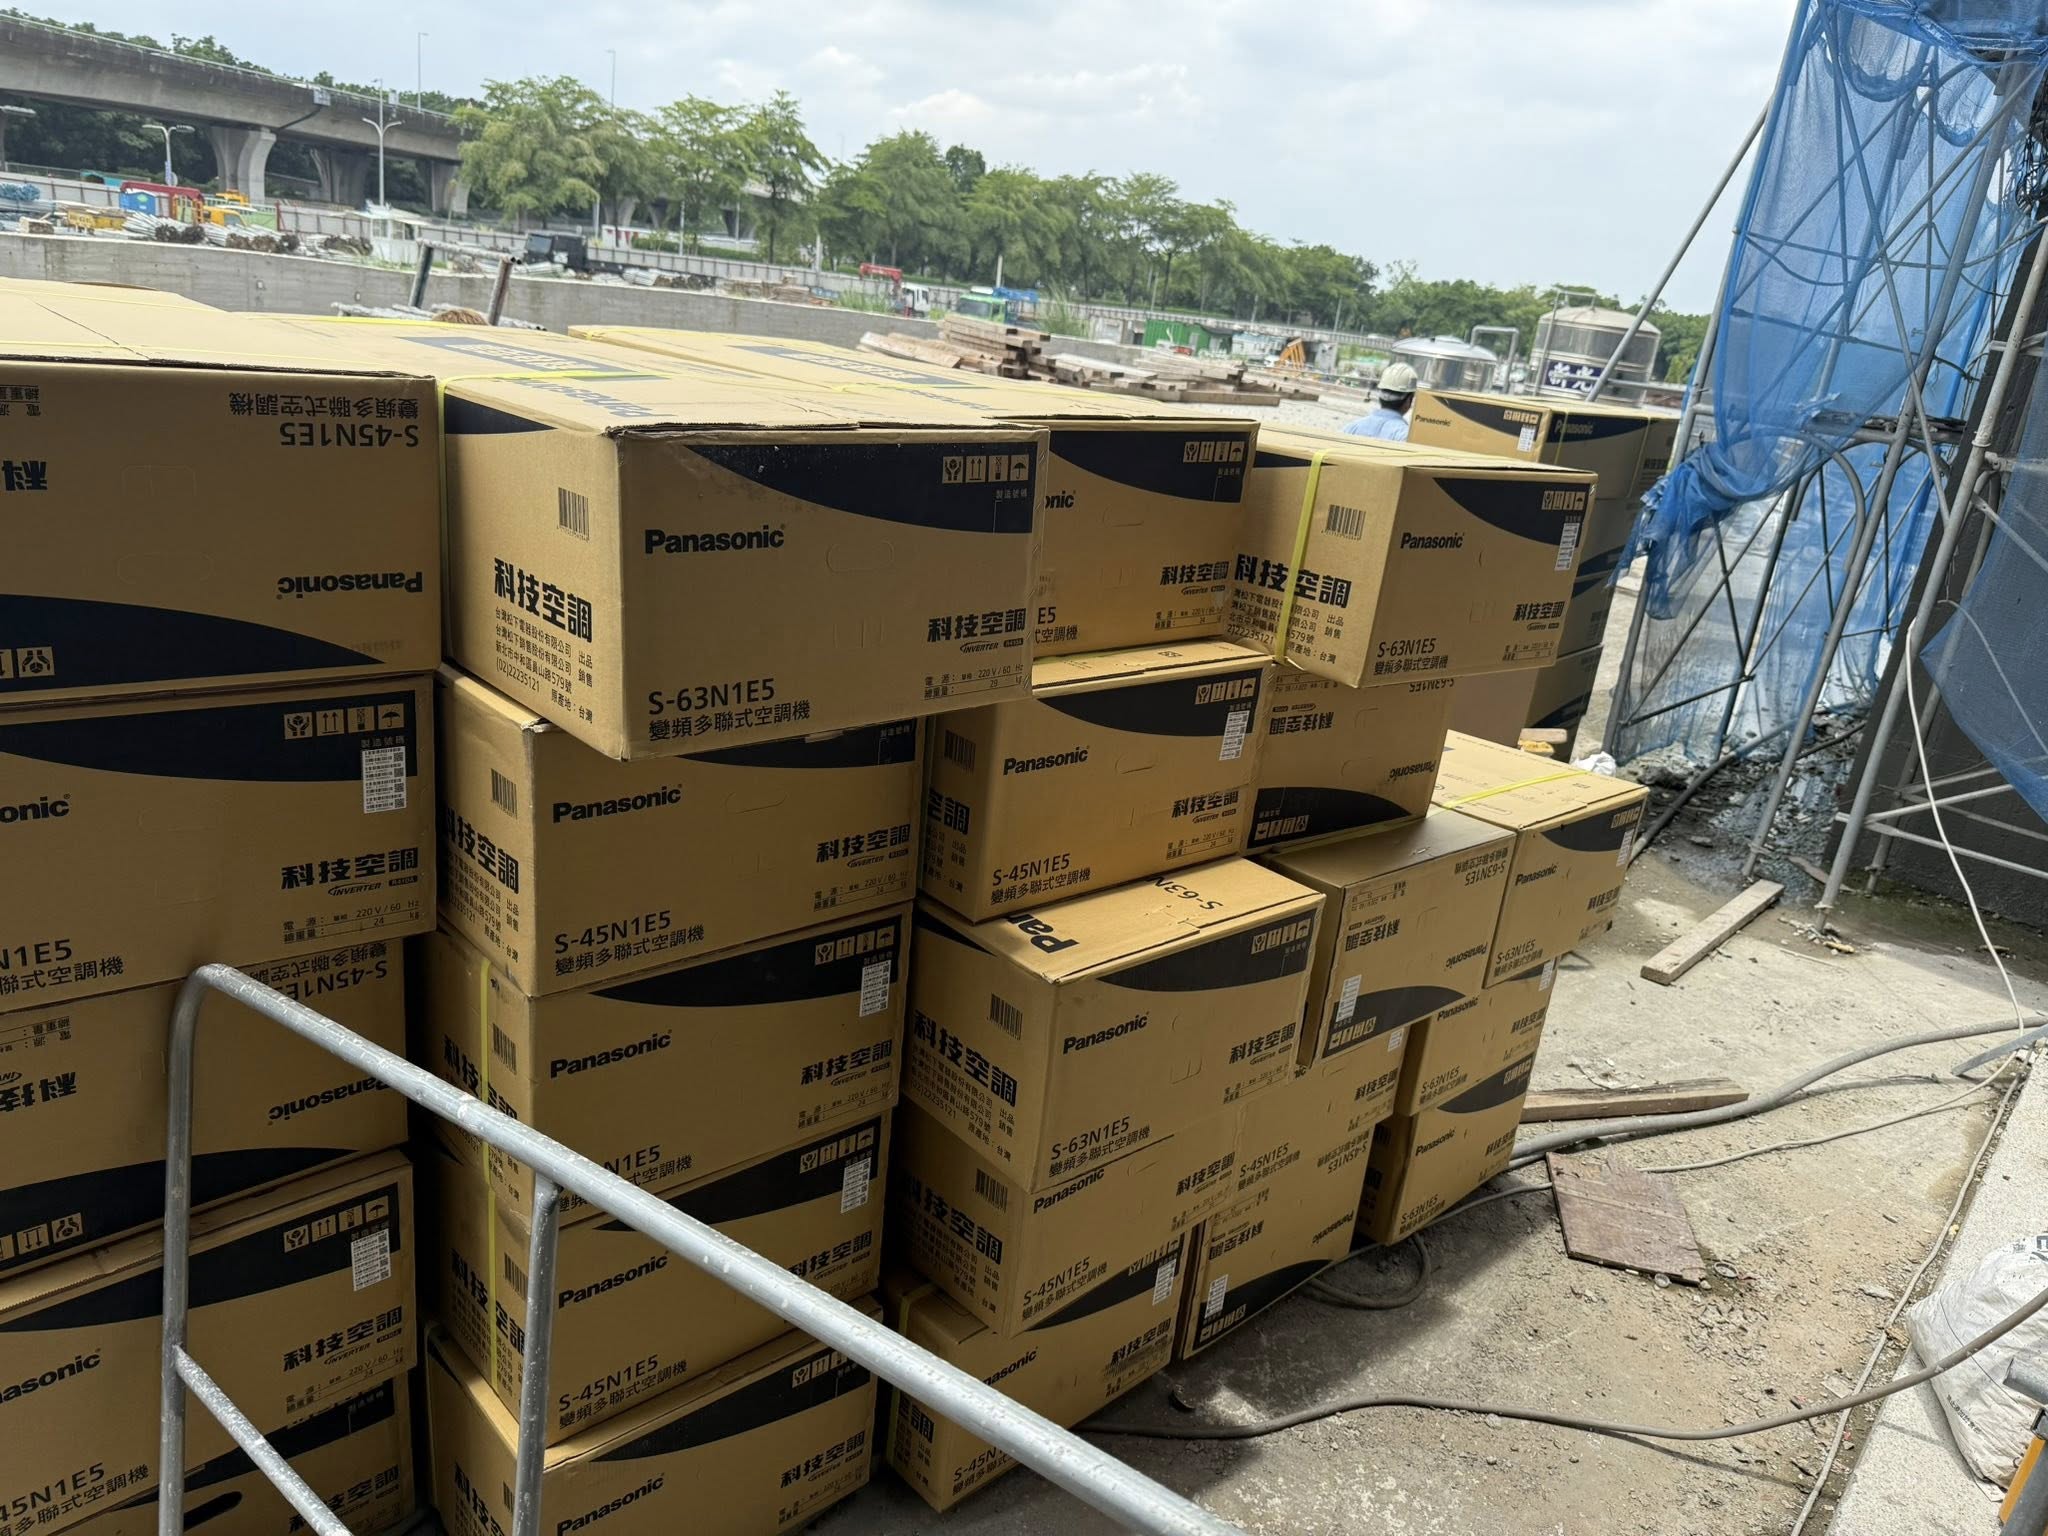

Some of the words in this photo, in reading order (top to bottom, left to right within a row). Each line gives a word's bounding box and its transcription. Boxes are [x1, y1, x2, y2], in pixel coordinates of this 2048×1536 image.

[230, 392, 419, 418] 變頻多聯式空調機
[279, 423, 419, 447] S-45N1E5
[645, 525, 785, 554] Panasonic
[1400, 532, 1464, 550] Panasonic
[277, 572, 423, 595] Panasonic
[1160, 561, 1230, 586] 科技空調
[1235, 553, 1352, 609] 科技空調
[494, 558, 593, 643] 科技空調
[1512, 600, 1566, 622] 科技空調
[927, 608, 1026, 643] 科技空調
[961, 640, 999, 654] INVERTER
[1377, 637, 1436, 658] S-63N1E5
[648, 678, 775, 716] S-63N1E5
[648, 700, 811, 742] 變頻多聯式空調機
[1268, 711, 1335, 736] 科技空調
[1003, 747, 1089, 776] Panasonic
[1389, 760, 1436, 782] Panasonic
[553, 785, 682, 824] Panasonic
[1171, 789, 1240, 819] 科技空調
[815, 823, 911, 864] 科技空調
[281, 846, 419, 890] 科技空調
[990, 866, 1091, 905] 變頻多聯式空調機
[992, 853, 1071, 887] S-45N1E5
[1464, 860, 1506, 887] S-63N1E5
[1515, 863, 1558, 887] Panasonic
[328, 882, 382, 897] INVERTER
[356, 904, 374, 919] 220
[390, 901, 401, 913] 60
[554, 909, 672, 955] S-45N1E5
[1344, 918, 1401, 953] 科技空調
[554, 924, 706, 976] 變頻多聯式空調機
[1445, 941, 1488, 970] Panasonic
[1496, 939, 1536, 967] S-63N1E5
[1437, 998, 1479, 1022] Panasonic
[1063, 1013, 1150, 1055] Panasonic
[1228, 1021, 1297, 1065] 科技空調
[551, 1031, 672, 1079] Panasonic
[800, 1038, 893, 1086] 科技空調
[912, 1008, 1018, 1109] 科技空調
[1353, 1067, 1399, 1102] 科技空調
[1420, 1066, 1460, 1094] S-63N1E5
[1048, 1124, 1151, 1178] 變頻多聯式空調機
[1051, 1115, 1131, 1160] S-63N1E5
[1415, 1129, 1456, 1156] Panasonic
[1175, 1151, 1236, 1197] 科技空調
[1239, 1142, 1289, 1177] S-45N1E5
[1326, 1143, 1368, 1174] S-45N1E5
[1034, 1165, 1105, 1215] Panasonic
[1312, 1210, 1354, 1246] Panasonic
[559, 1254, 669, 1309] Panasonic
[1023, 1256, 1092, 1307] S-45N1E5
[283, 1305, 403, 1372] 科技空調
[0, 1351, 101, 1404] asonic
[559, 1354, 659, 1412] S-45N1E5
[559, 1358, 688, 1432] 變頻多聯式空調機
[780, 1429, 867, 1489] 科技空調
[557, 1474, 665, 1536] Panasonic
